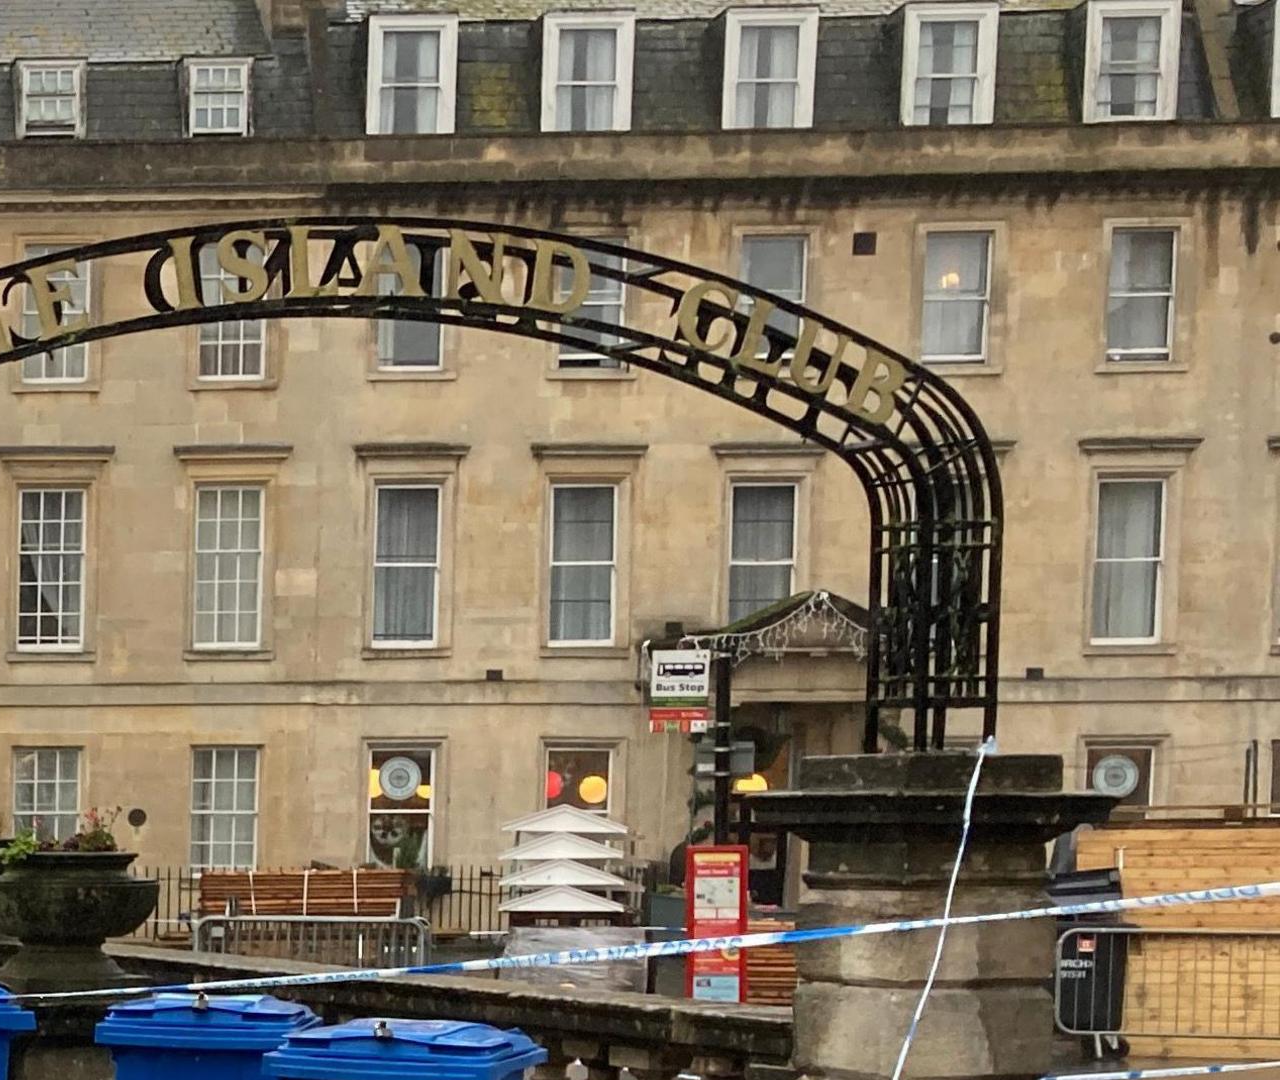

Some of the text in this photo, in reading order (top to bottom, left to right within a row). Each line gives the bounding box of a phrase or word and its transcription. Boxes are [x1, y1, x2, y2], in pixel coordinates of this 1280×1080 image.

[166, 224, 592, 315] ISLAND
[678, 280, 907, 425] CLUB
[656, 683, 705, 693] Bus Stop
